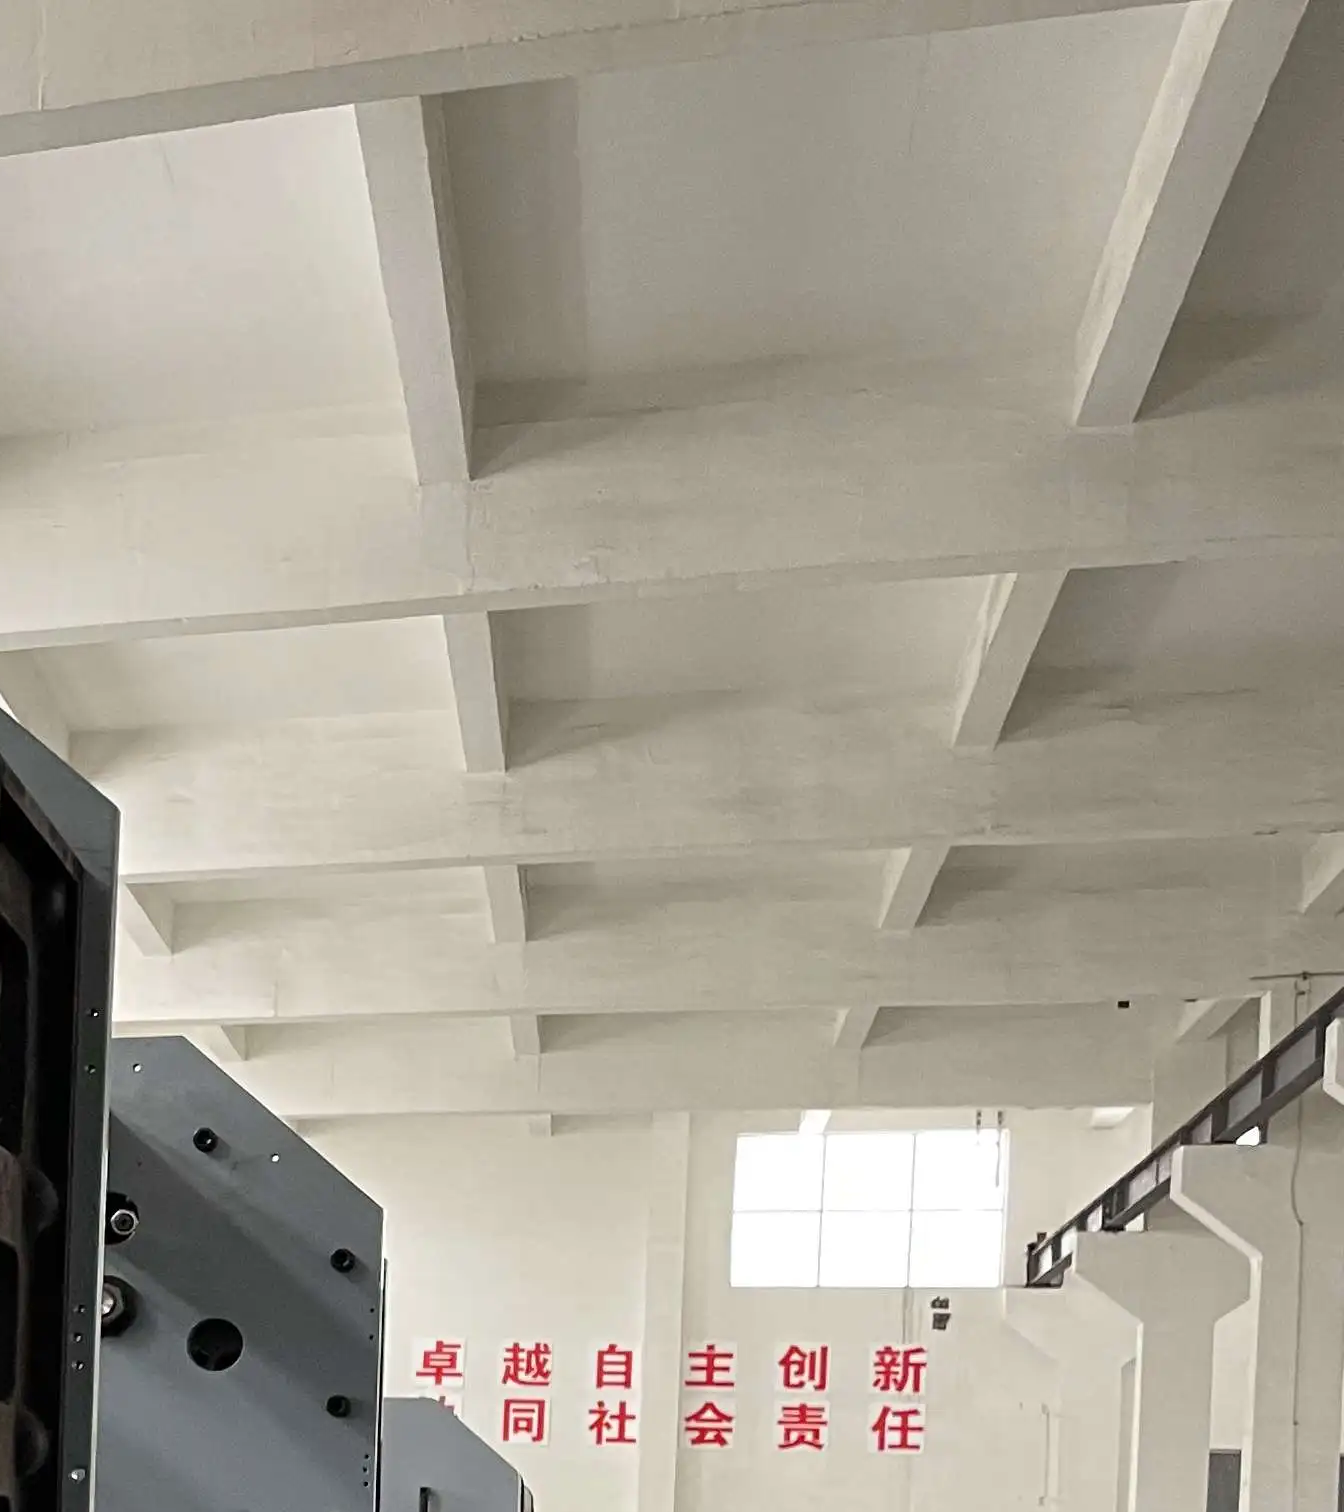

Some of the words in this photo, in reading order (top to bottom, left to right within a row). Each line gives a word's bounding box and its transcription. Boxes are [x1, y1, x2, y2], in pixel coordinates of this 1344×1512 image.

[415, 1340, 927, 1393] 卓越自主创新
[439, 1396, 924, 1452] 同社会责任
